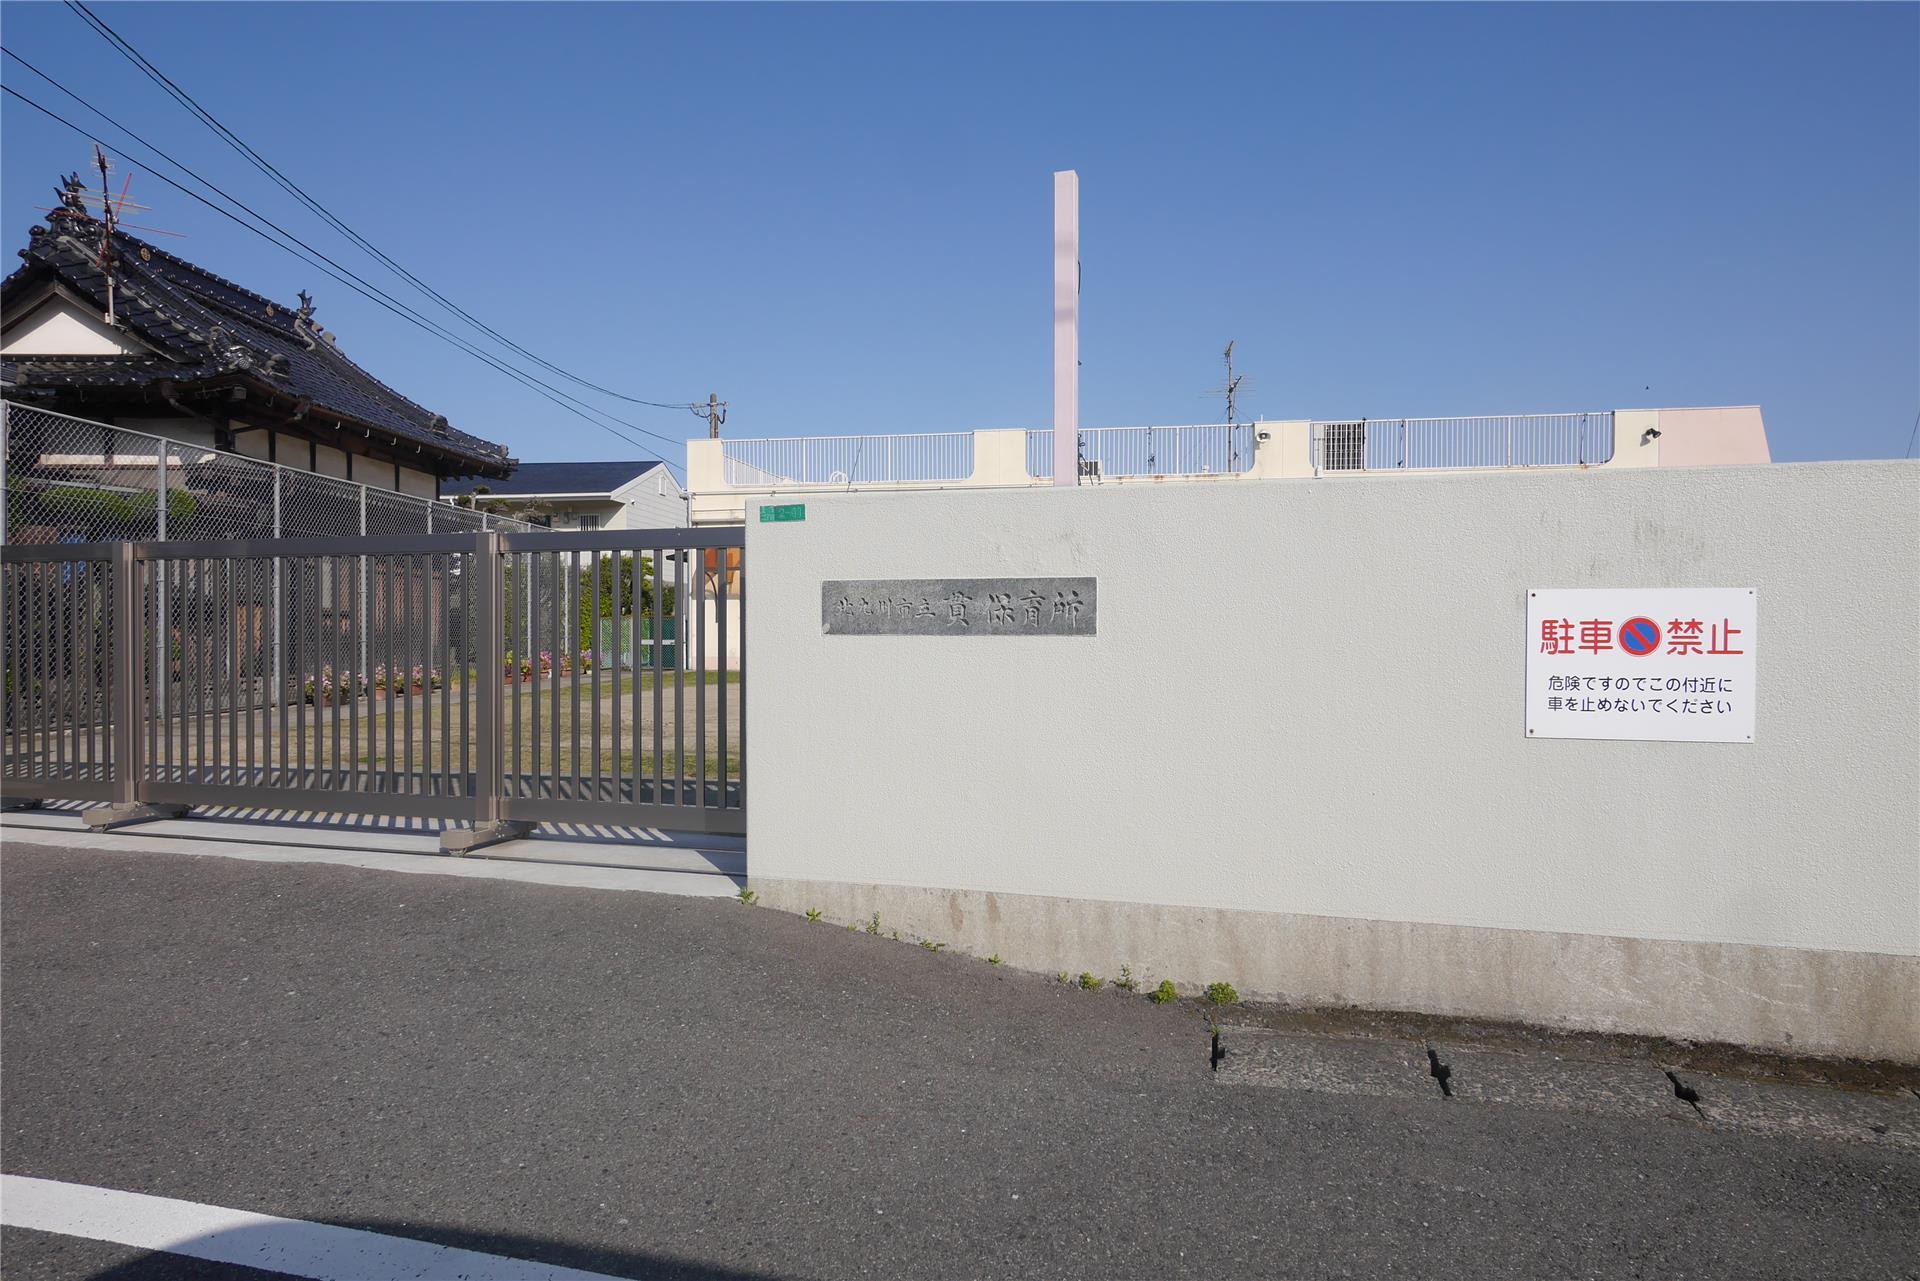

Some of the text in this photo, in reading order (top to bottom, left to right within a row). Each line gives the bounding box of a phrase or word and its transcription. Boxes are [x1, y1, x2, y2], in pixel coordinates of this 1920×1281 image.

[1541, 618, 1744, 656] 駐車 禁止
[1548, 674, 1733, 694] 危険ですのでこの付近に
[1547, 695, 1732, 715] 車を止めないでください
